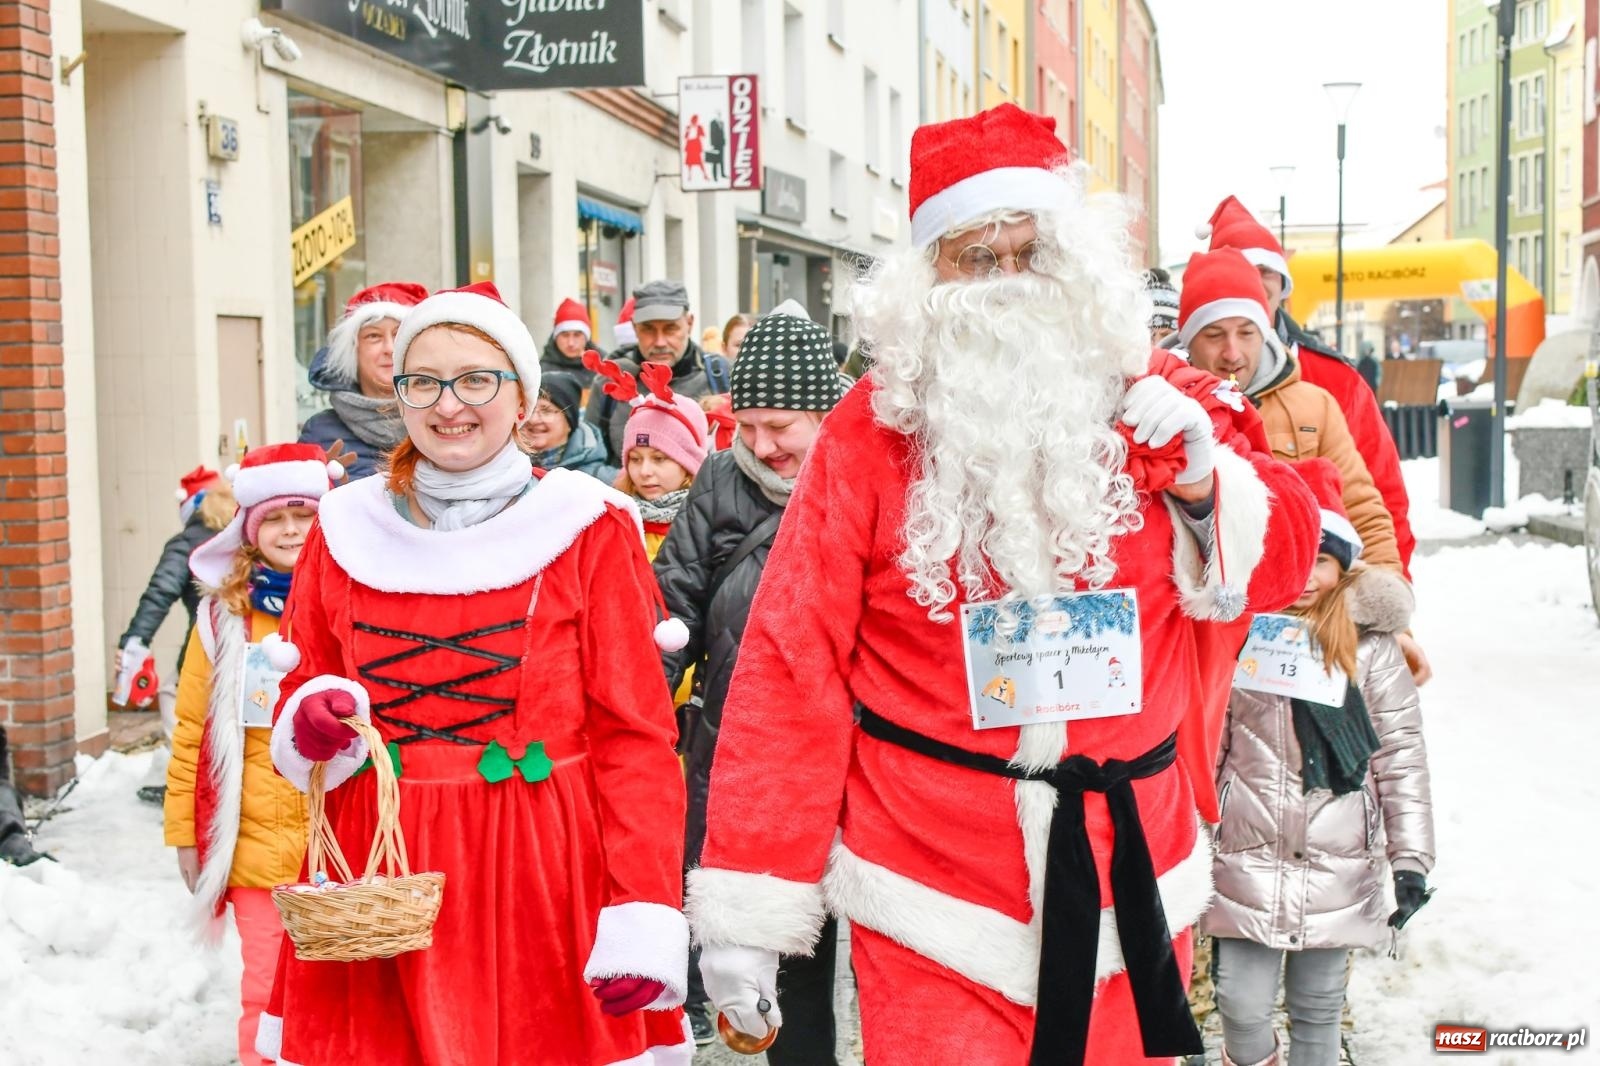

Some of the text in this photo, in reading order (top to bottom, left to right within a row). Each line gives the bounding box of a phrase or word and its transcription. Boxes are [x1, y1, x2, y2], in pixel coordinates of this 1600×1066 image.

[503, 29, 618, 73] Złotnik
[291, 224, 327, 276] ZŁOTO
[994, 652, 1033, 667] Sportowy
[1035, 649, 1062, 662] spacer
[1071, 644, 1110, 658] Mikołajem
[1053, 669, 1064, 690] 1
[1280, 663, 1298, 677] 13
[1035, 702, 1081, 714] Racibórz
